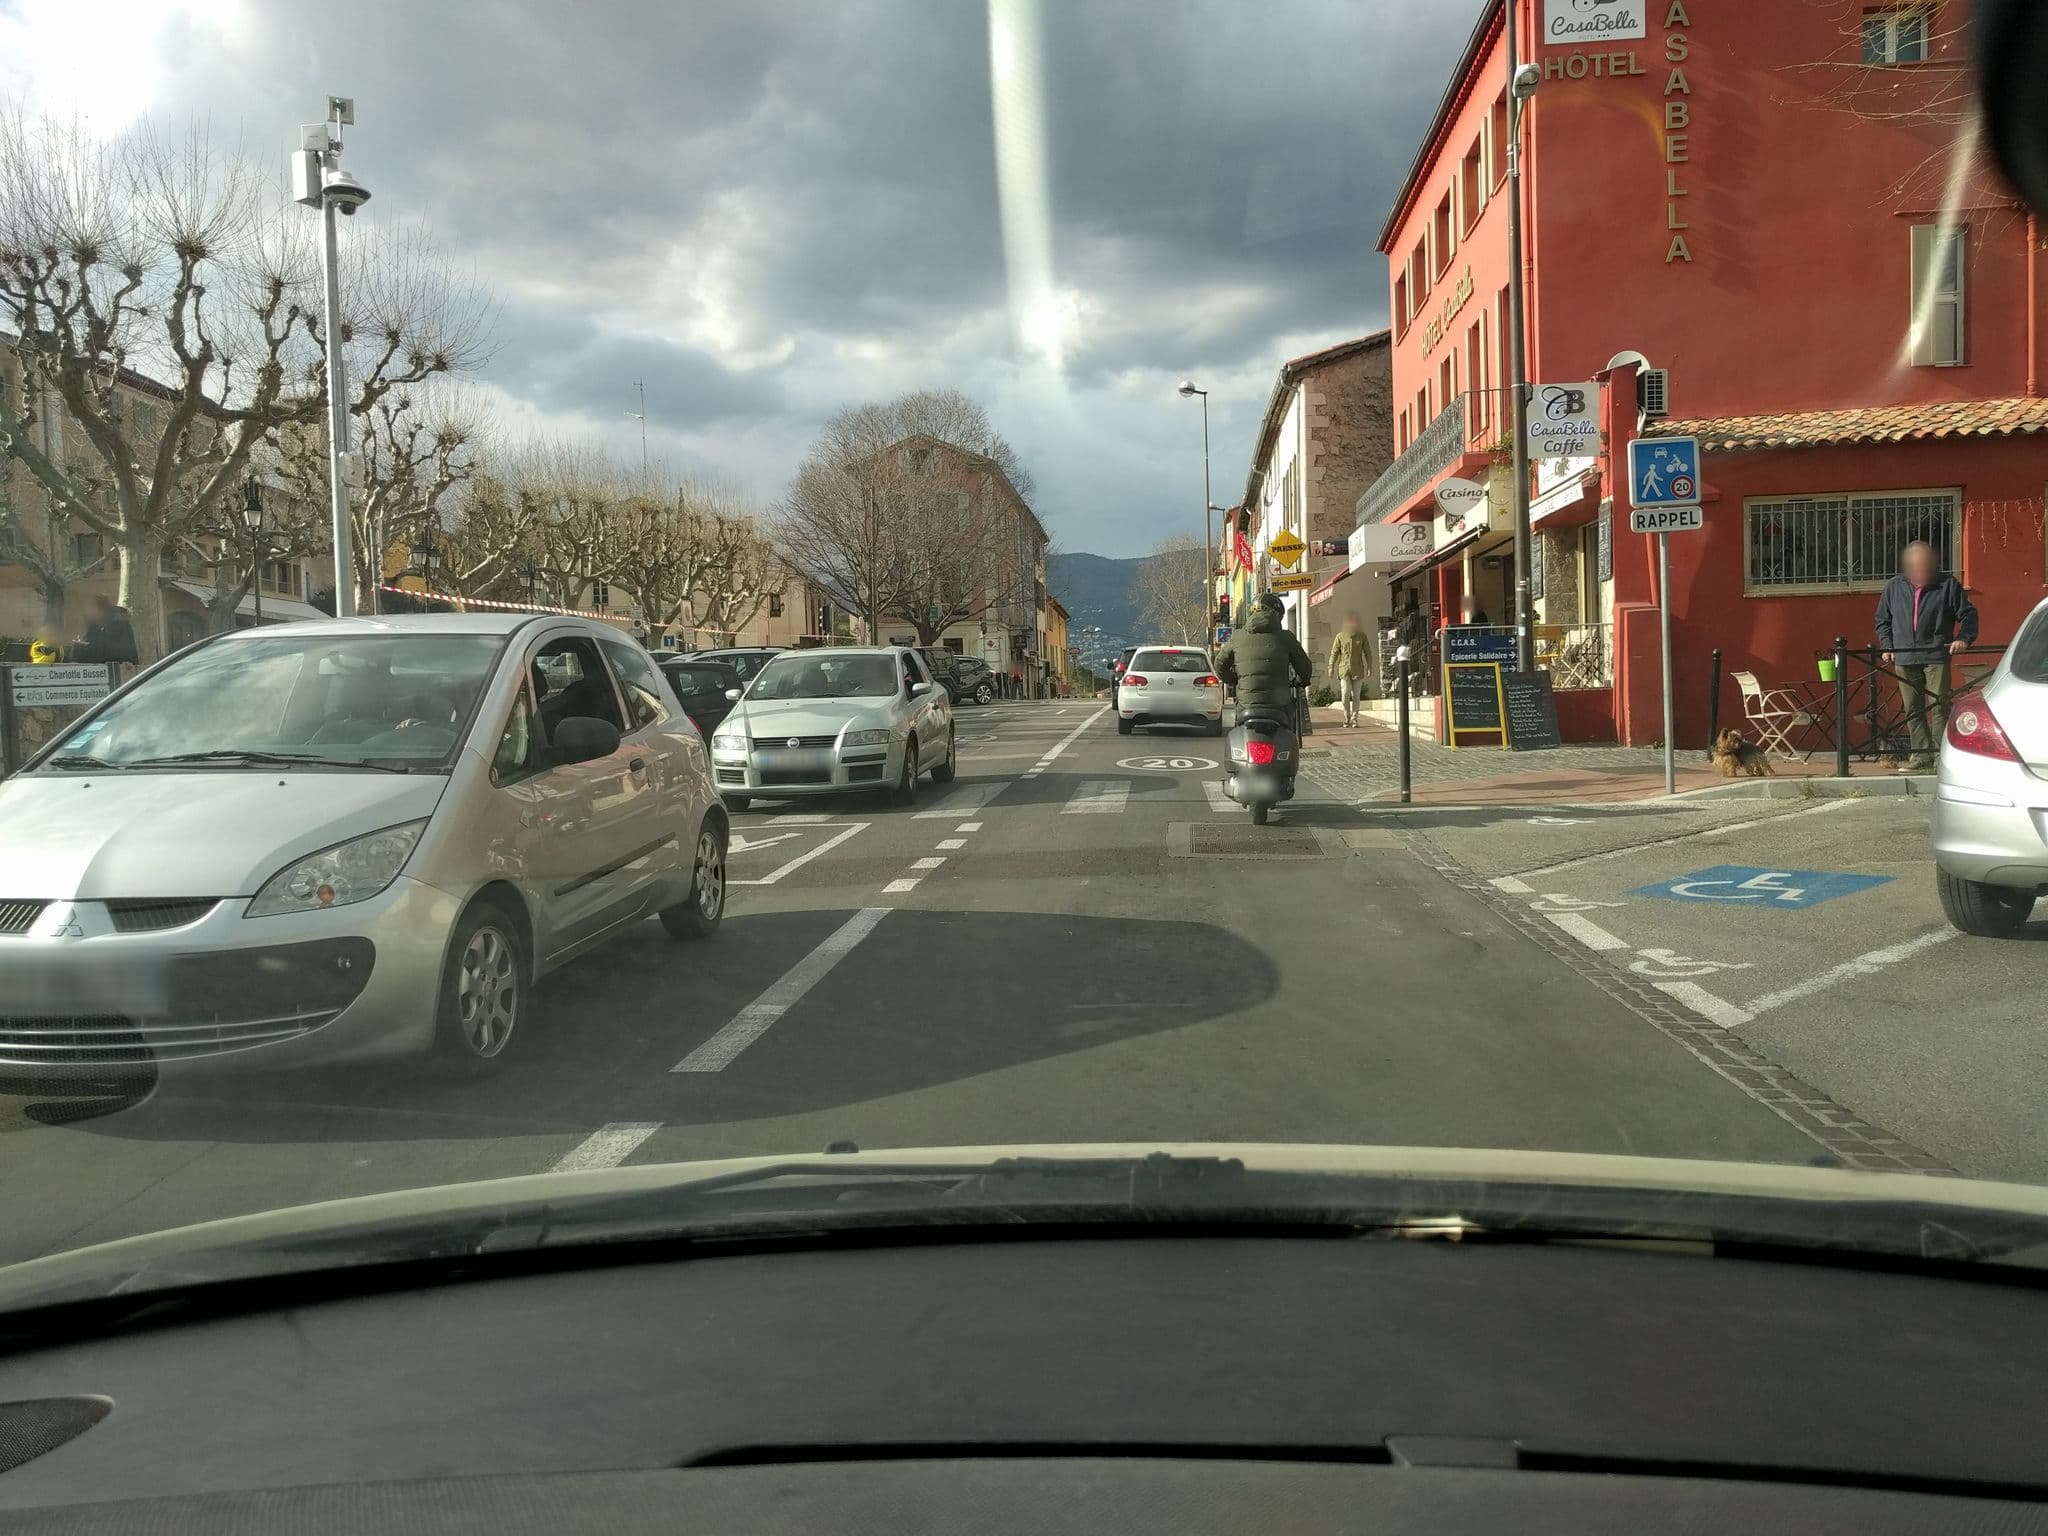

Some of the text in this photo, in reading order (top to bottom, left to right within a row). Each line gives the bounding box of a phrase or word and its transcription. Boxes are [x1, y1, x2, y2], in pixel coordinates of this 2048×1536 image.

[1551, 10, 1639, 36] CasaBella
[1544, 48, 1647, 80] HÔTEL
[1530, 420, 1597, 437] CasaBella
[1544, 438, 1584, 455] Caffé
[1676, 482, 1690, 492] 20
[1439, 487, 1483, 500] Casino
[1636, 511, 1698, 529] RAPPEL
[1272, 543, 1304, 553] PRESSE
[1272, 577, 1312, 588] nice-matin
[1451, 651, 1507, 660] Epicerie Solidaire
[49, 670, 81, 680] Charlotte
[45, 689, 79, 700] Commerce
[1142, 759, 1194, 768] 20
